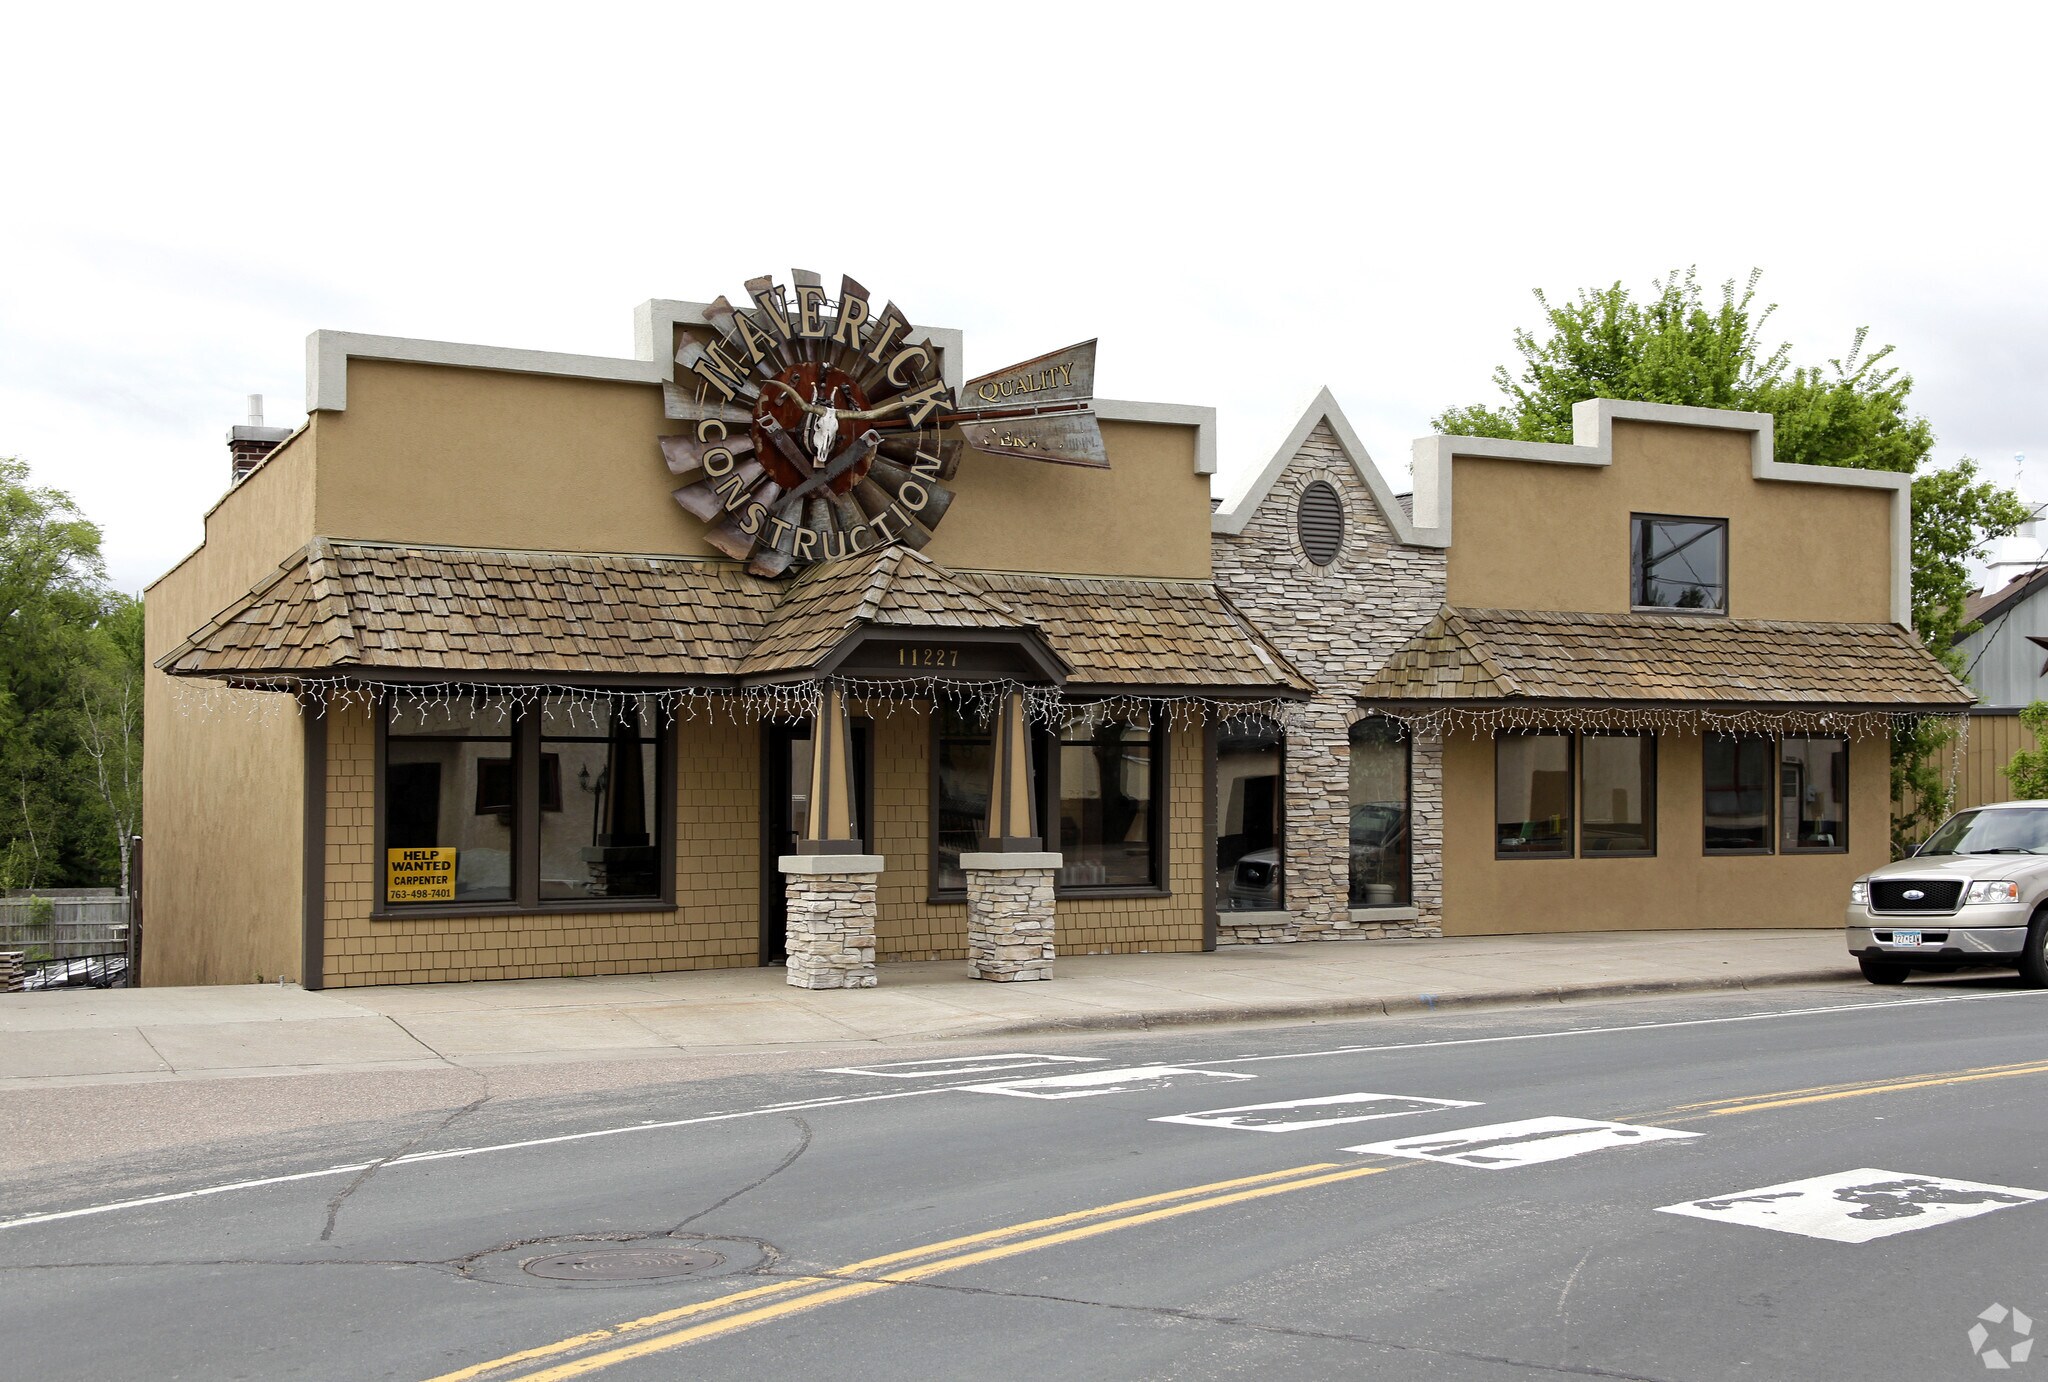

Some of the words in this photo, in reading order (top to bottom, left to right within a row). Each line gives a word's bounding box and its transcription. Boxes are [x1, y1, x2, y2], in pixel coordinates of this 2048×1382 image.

[692, 284, 953, 430] MAVERICK
[978, 362, 1074, 403] QUALITY
[697, 418, 942, 561] CONSTRUCTION
[899, 648, 958, 667] 11227
[404, 851, 439, 860] HELP
[392, 861, 451, 871] WANTED
[394, 876, 448, 885] CARPENTER
[390, 889, 451, 899] 763-498-7401
